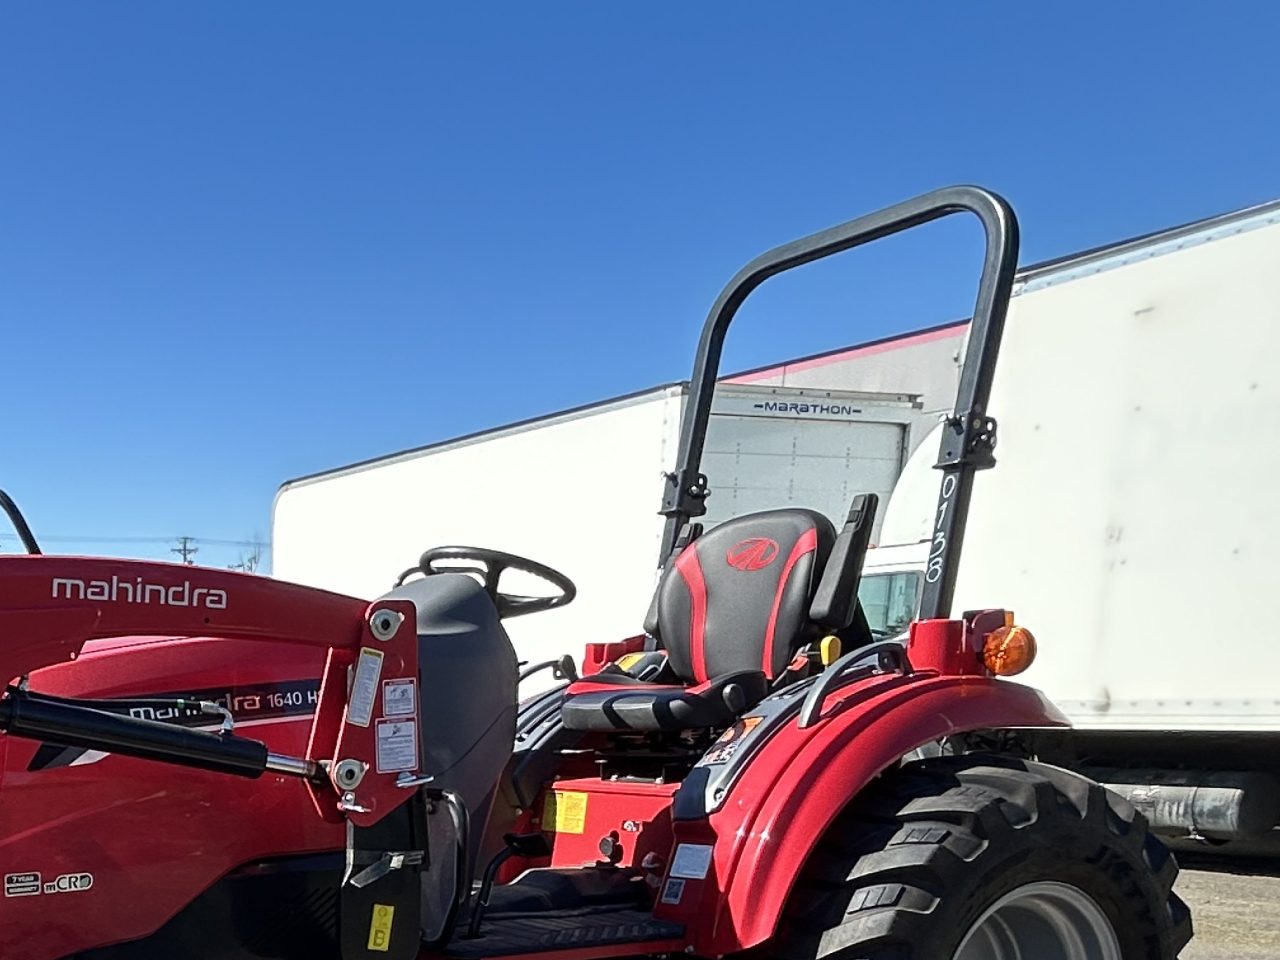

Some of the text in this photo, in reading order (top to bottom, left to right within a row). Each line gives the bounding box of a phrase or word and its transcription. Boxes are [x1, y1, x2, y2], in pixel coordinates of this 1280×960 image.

[926, 475, 956, 583] 0138
[52, 575, 228, 609] mahindra
[266, 691, 303, 708] 1640
[307, 690, 322, 704] H
